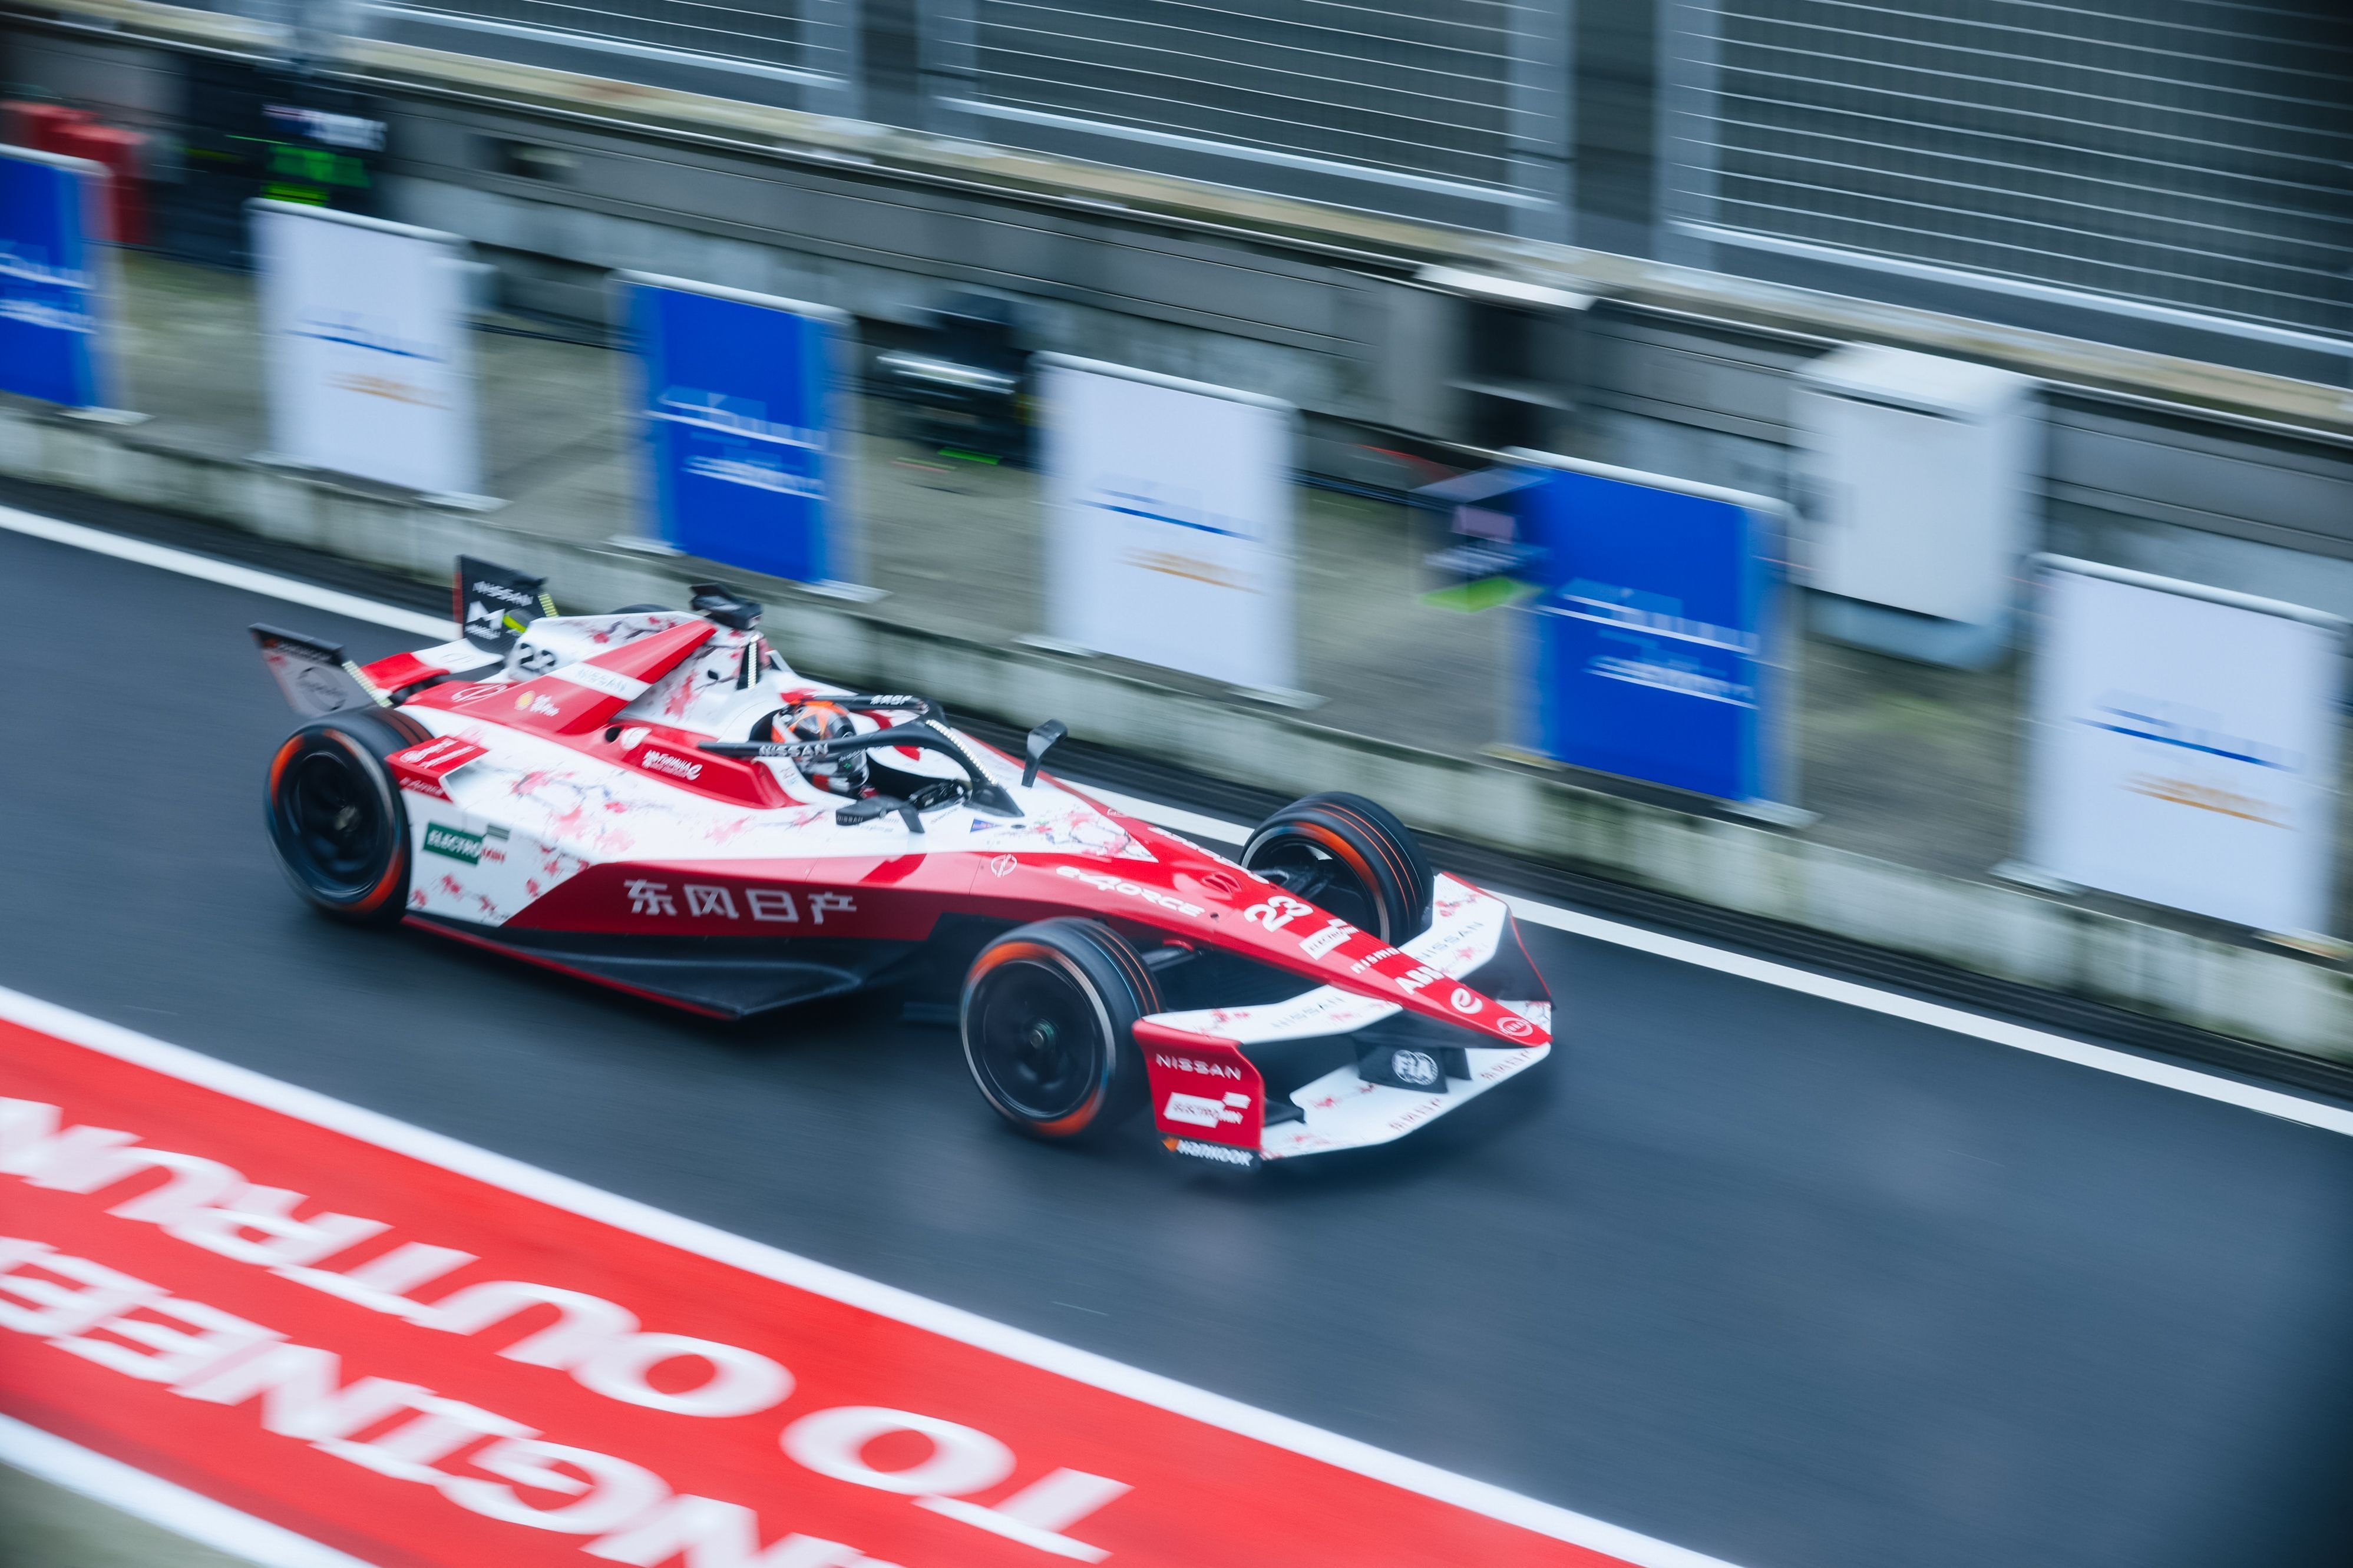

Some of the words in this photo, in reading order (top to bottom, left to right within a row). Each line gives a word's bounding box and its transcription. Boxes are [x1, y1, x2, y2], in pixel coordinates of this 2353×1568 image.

[759, 743, 829, 757] NISSAN
[837, 815, 863, 823] NISSAN
[624, 878, 857, 925] 东风日产
[1243, 895, 1314, 933] 23
[1415, 921, 1484, 961] NISSAN
[1270, 995, 1347, 1030] NISSAN
[1156, 1053, 1242, 1081] NISSAN
[1176, 1139, 1254, 1167] HANKOOK
[0, 1235, 907, 1568] NGINEE
[778, 1404, 1136, 1565] TO
